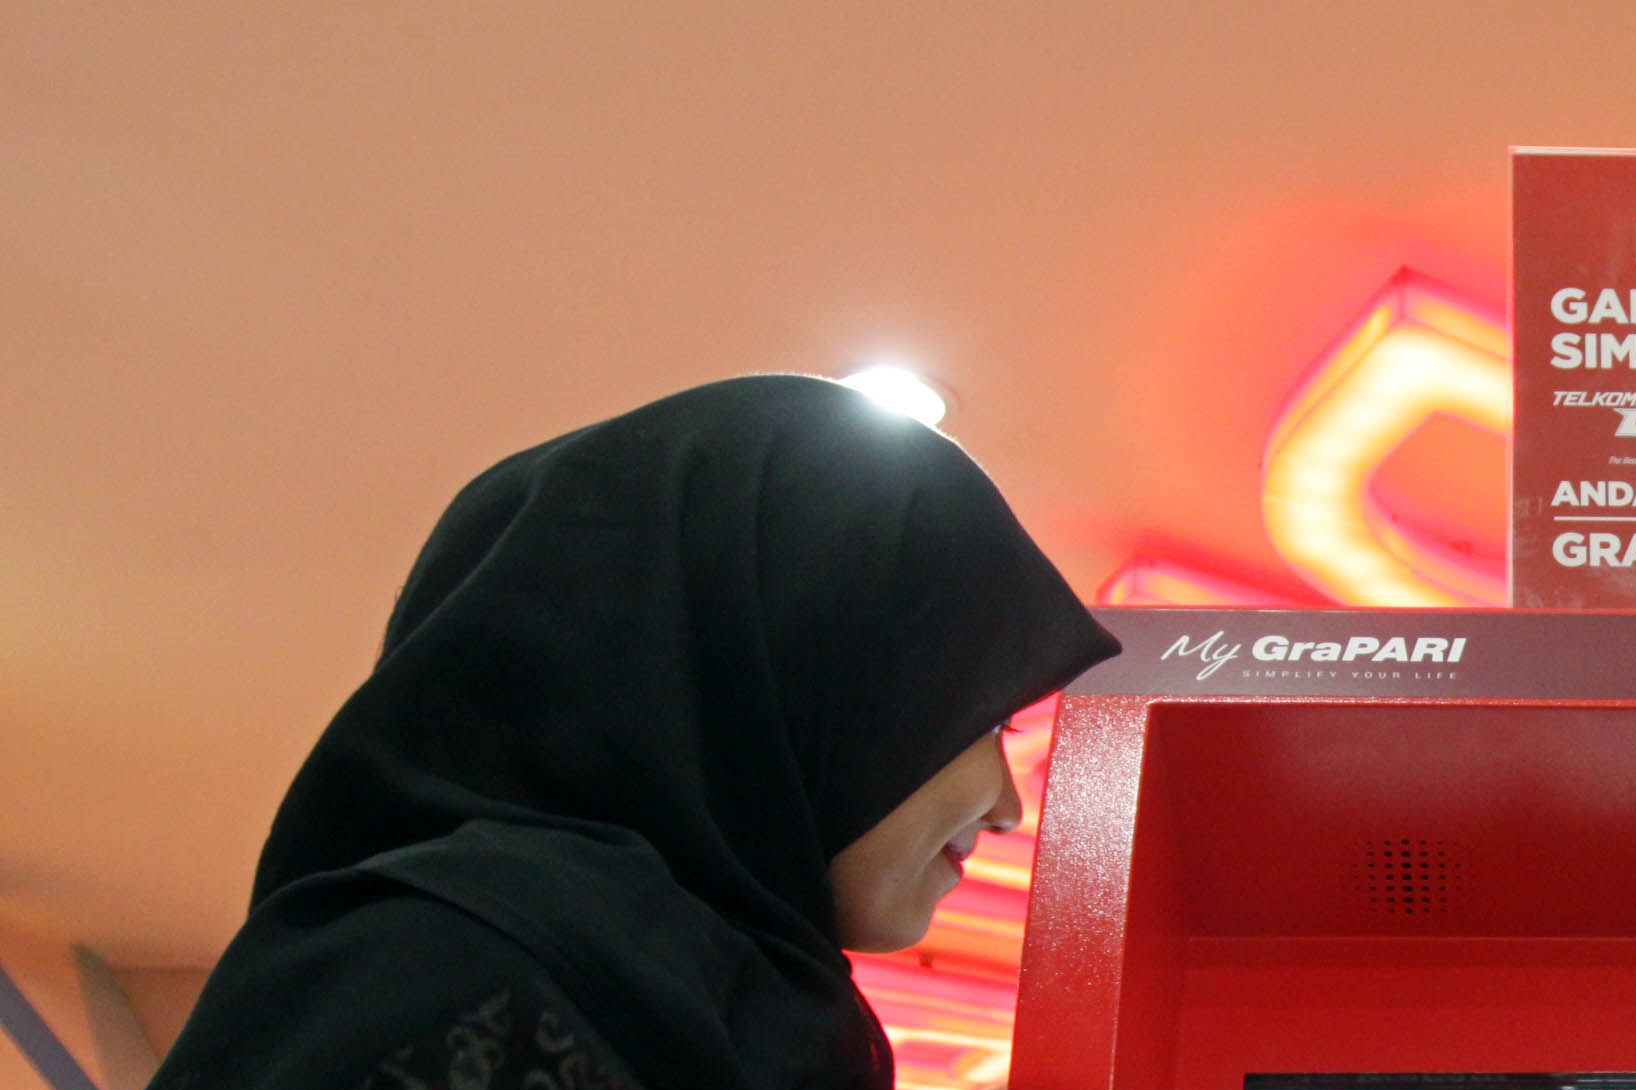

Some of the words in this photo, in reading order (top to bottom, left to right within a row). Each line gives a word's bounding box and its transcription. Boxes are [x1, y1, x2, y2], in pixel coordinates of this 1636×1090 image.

[1161, 630, 1242, 681] My
[1252, 634, 1467, 663] GraPARI
[1242, 670, 1337, 680] SIMPLIFY
[1351, 671, 1401, 680] YOUR
[1415, 671, 1457, 681] LIFE
